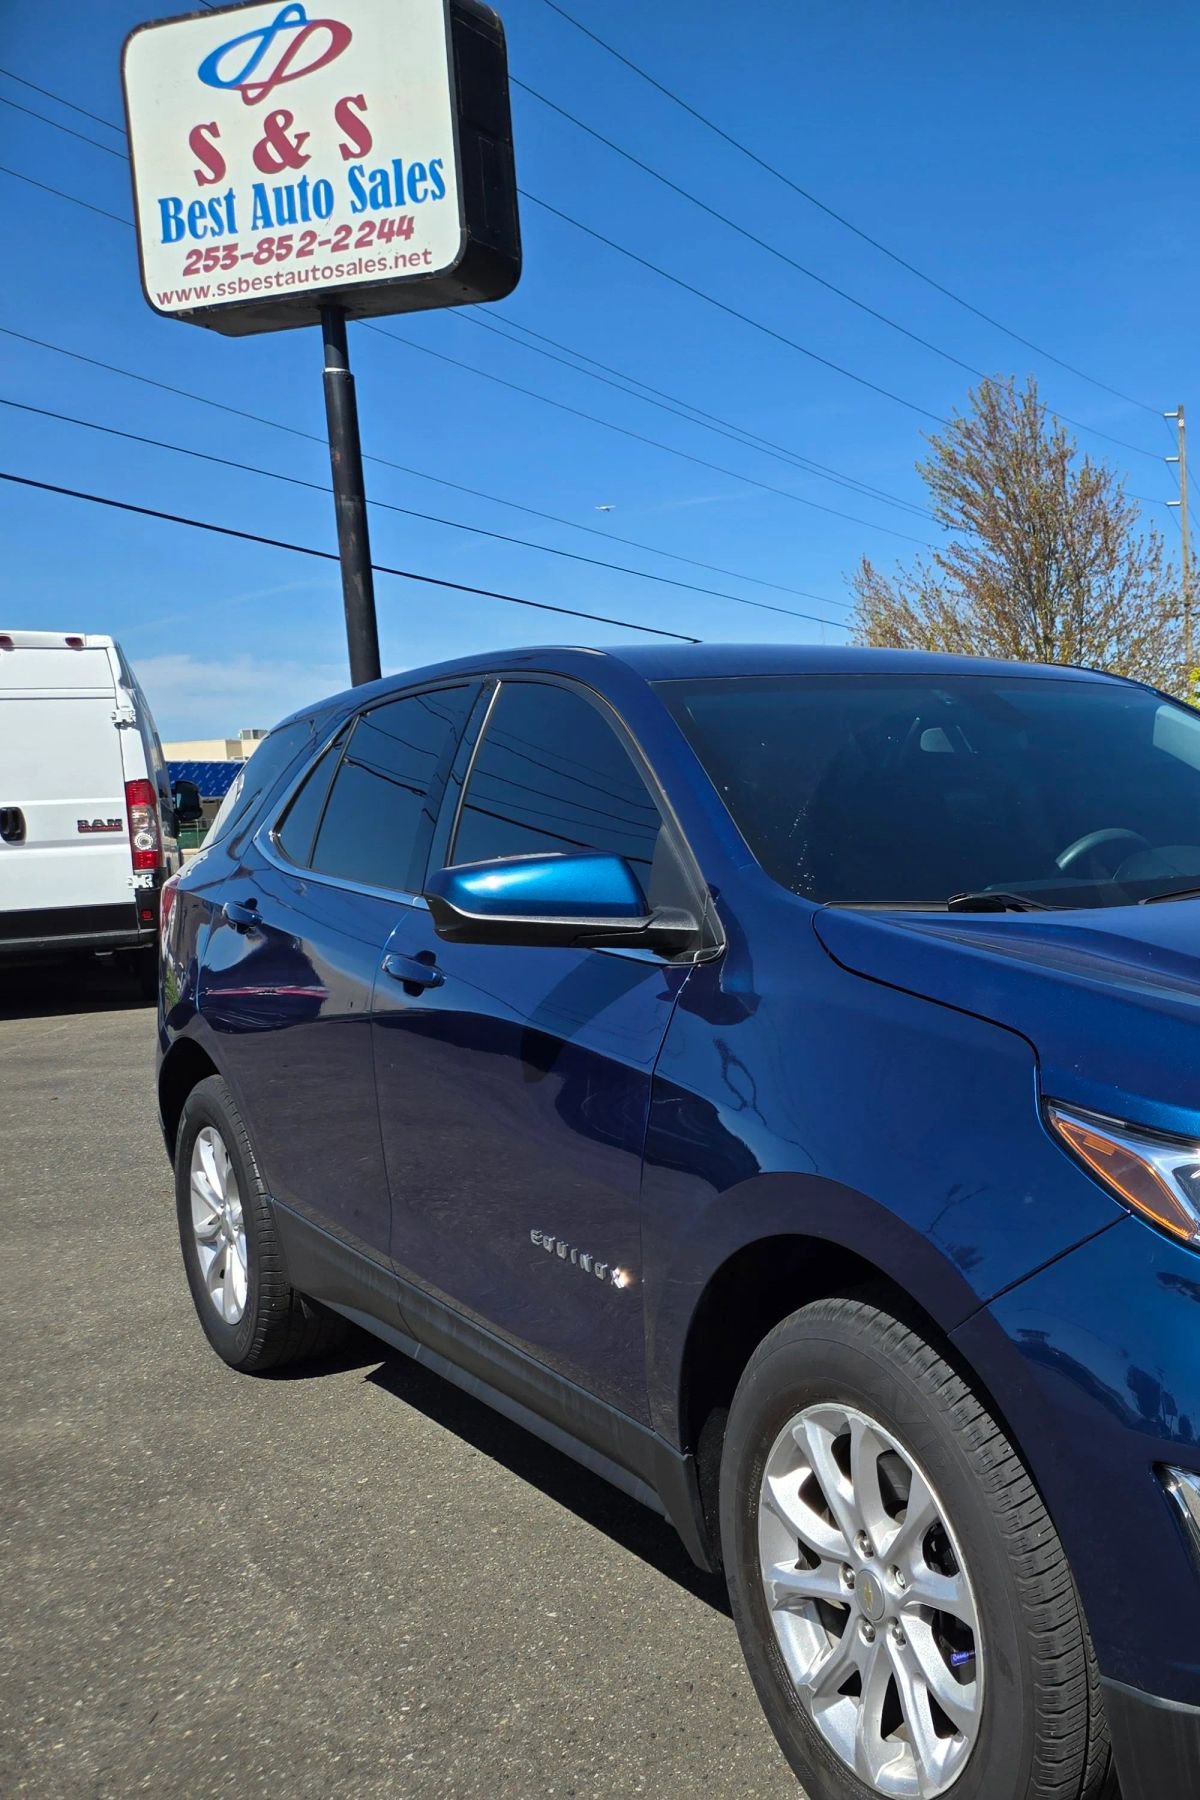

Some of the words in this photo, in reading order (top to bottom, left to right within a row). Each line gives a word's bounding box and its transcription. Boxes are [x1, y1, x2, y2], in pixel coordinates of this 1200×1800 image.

[188, 121, 227, 187] S
[252, 109, 311, 175] &
[334, 94, 373, 161] S
[157, 187, 239, 244] Best
[250, 174, 334, 231] Auto
[348, 156, 446, 214] Sales
[156, 248, 432, 306] www.ssbestautosales.net
[182, 215, 415, 277] 253-852-2244
[77, 818, 123, 833] RAM
